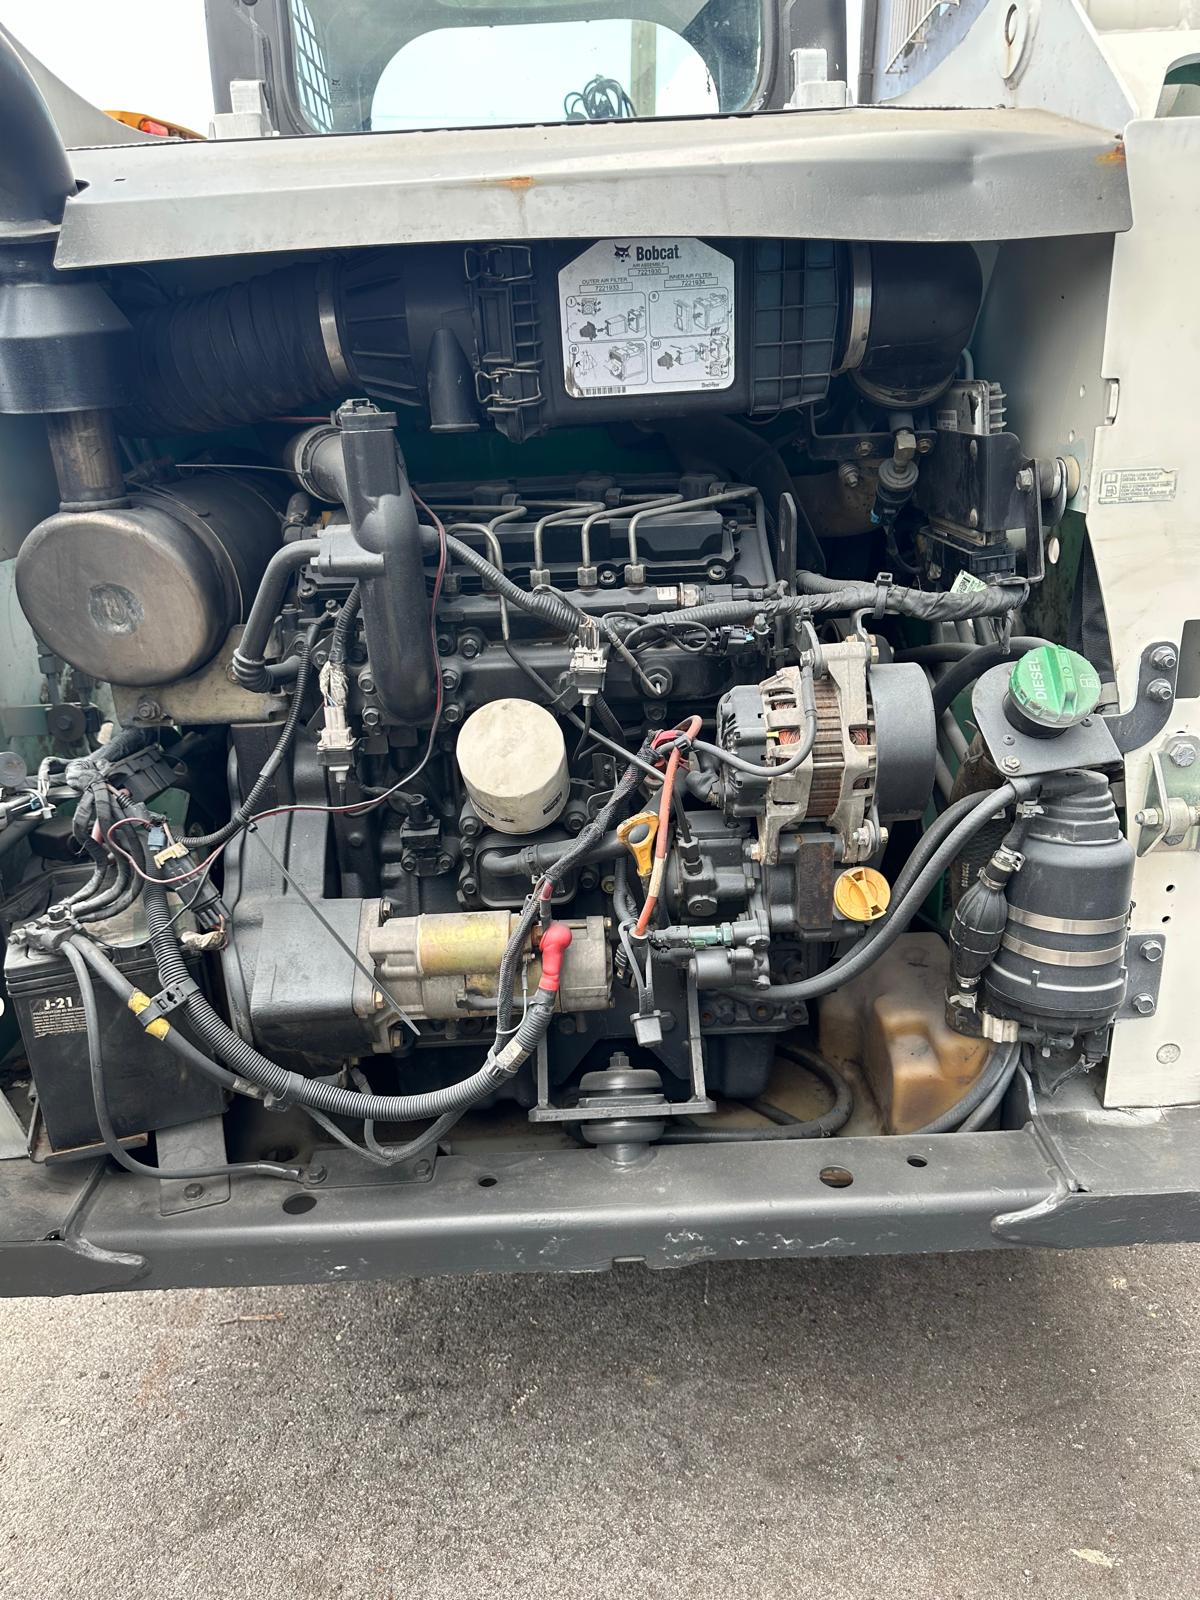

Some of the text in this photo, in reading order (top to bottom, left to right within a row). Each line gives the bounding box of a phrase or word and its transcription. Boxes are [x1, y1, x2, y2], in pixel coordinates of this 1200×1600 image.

[636, 244, 680, 261] Bobcat
[1028, 657, 1047, 700] DIESEL
[43, 996, 73, 1011] J-21
